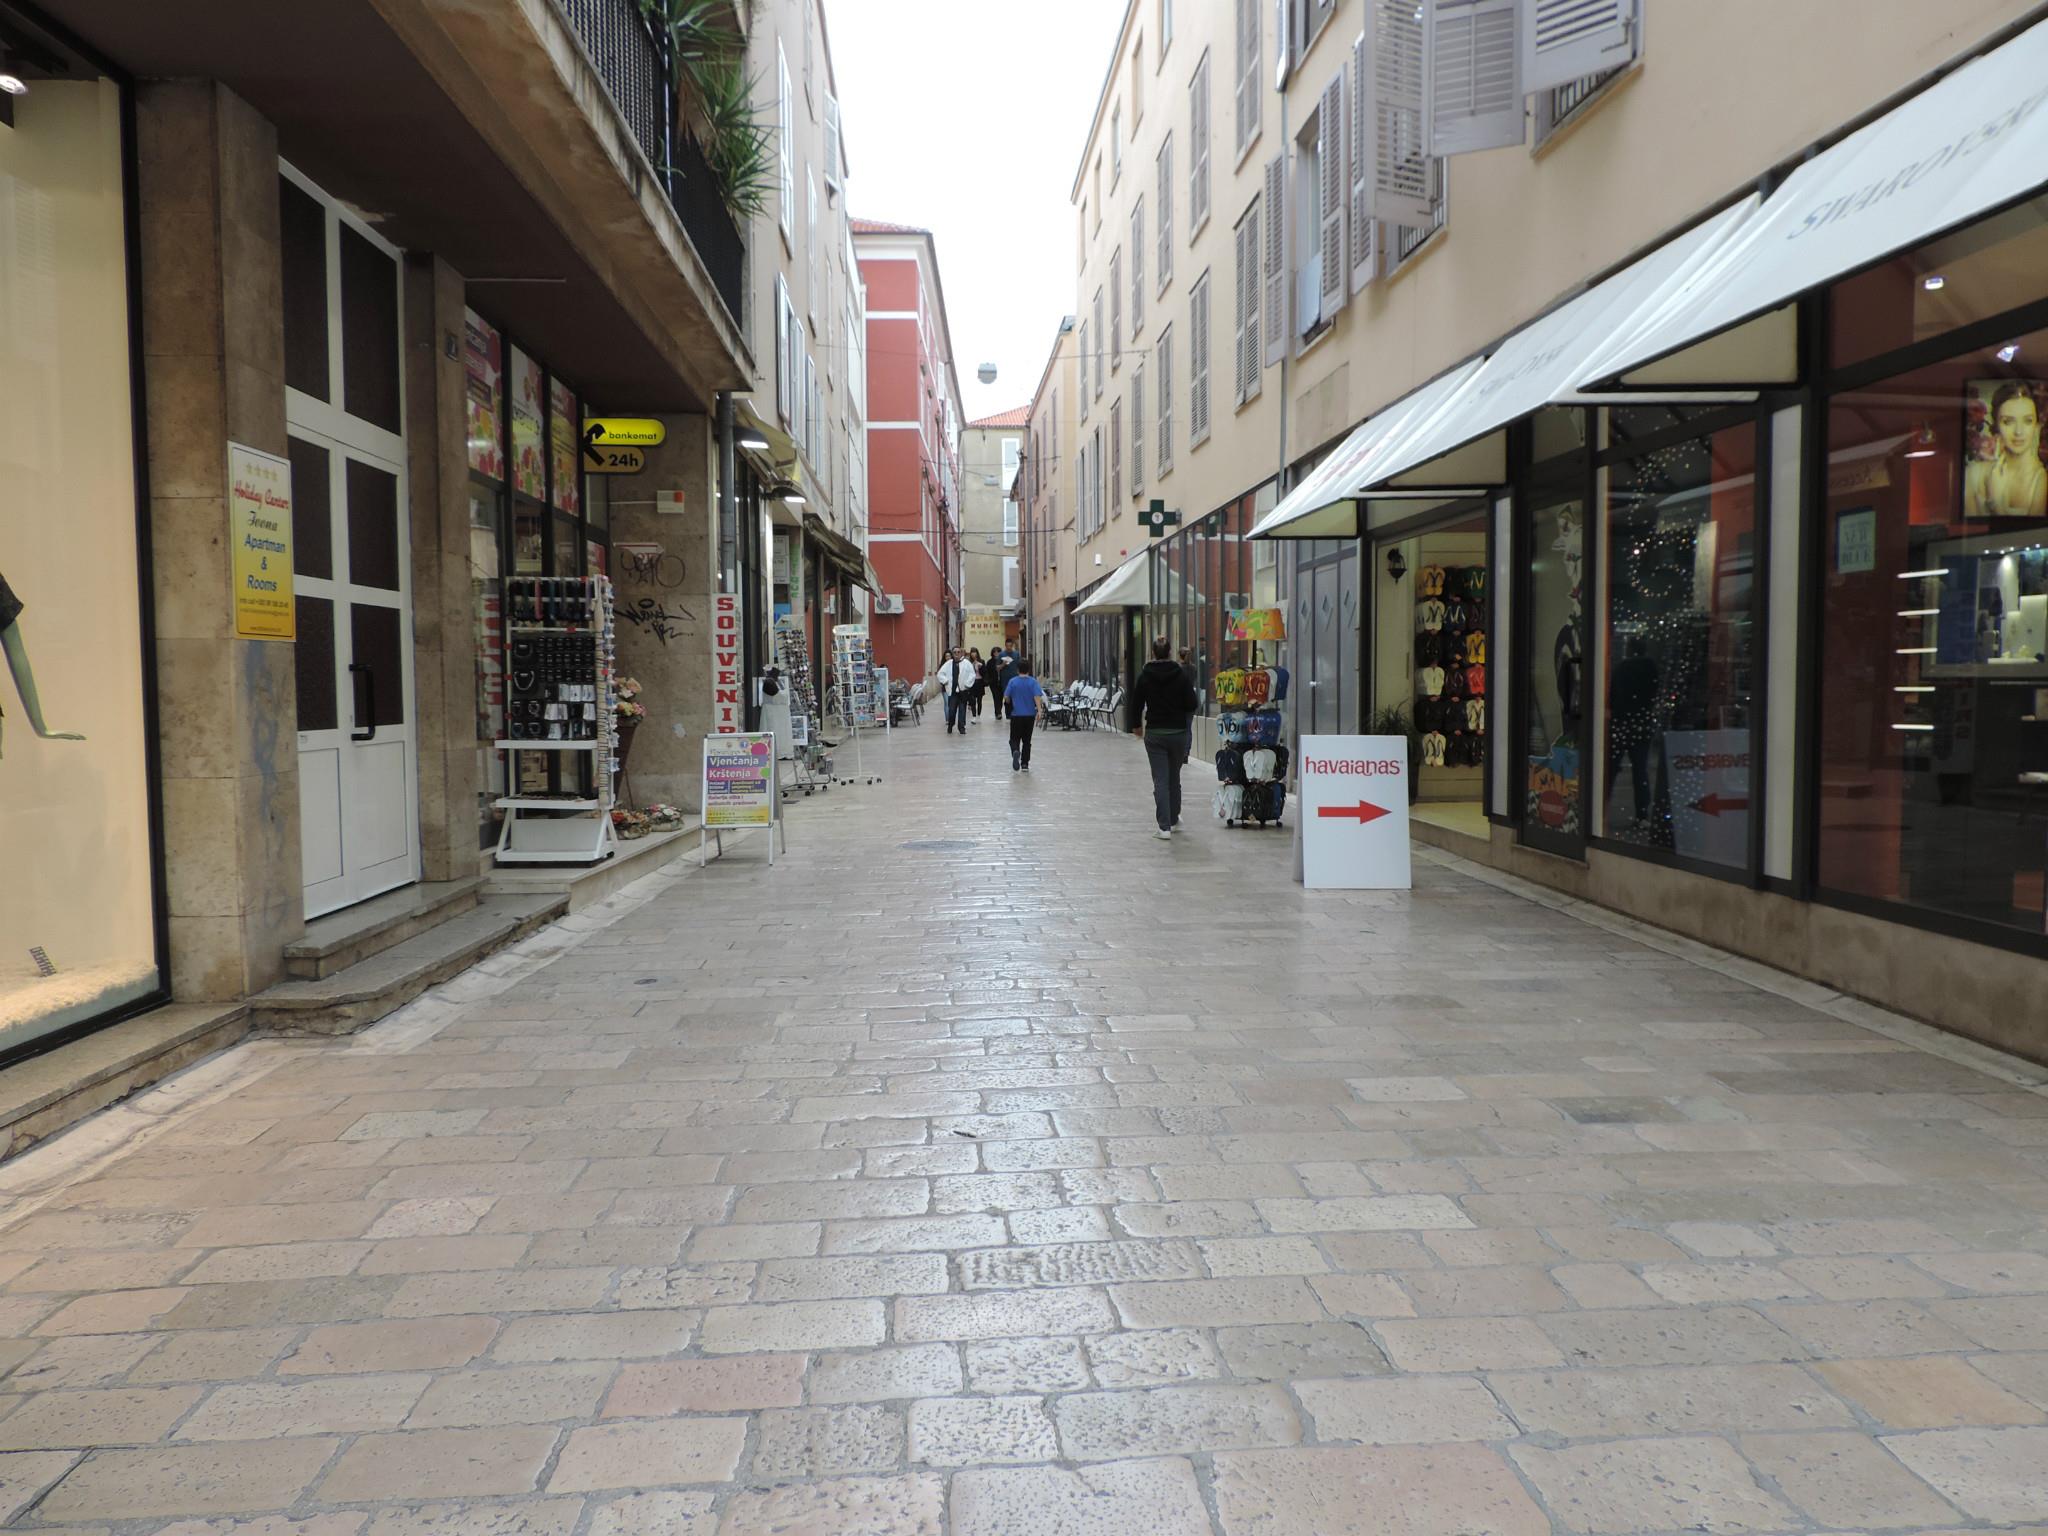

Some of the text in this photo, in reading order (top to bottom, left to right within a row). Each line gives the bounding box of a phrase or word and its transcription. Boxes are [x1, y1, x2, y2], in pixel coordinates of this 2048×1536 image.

[1786, 84, 2048, 241] SWAROVSK
[608, 431, 657, 440] bankomat
[609, 453, 639, 467] 24h
[234, 480, 289, 510] Holiday Center
[260, 555, 268, 571] &
[247, 574, 278, 593] Rooms
[709, 756, 760, 767] Vjenčanja
[1305, 756, 1401, 777] havaianas
[709, 769, 751, 778] Krštenja
